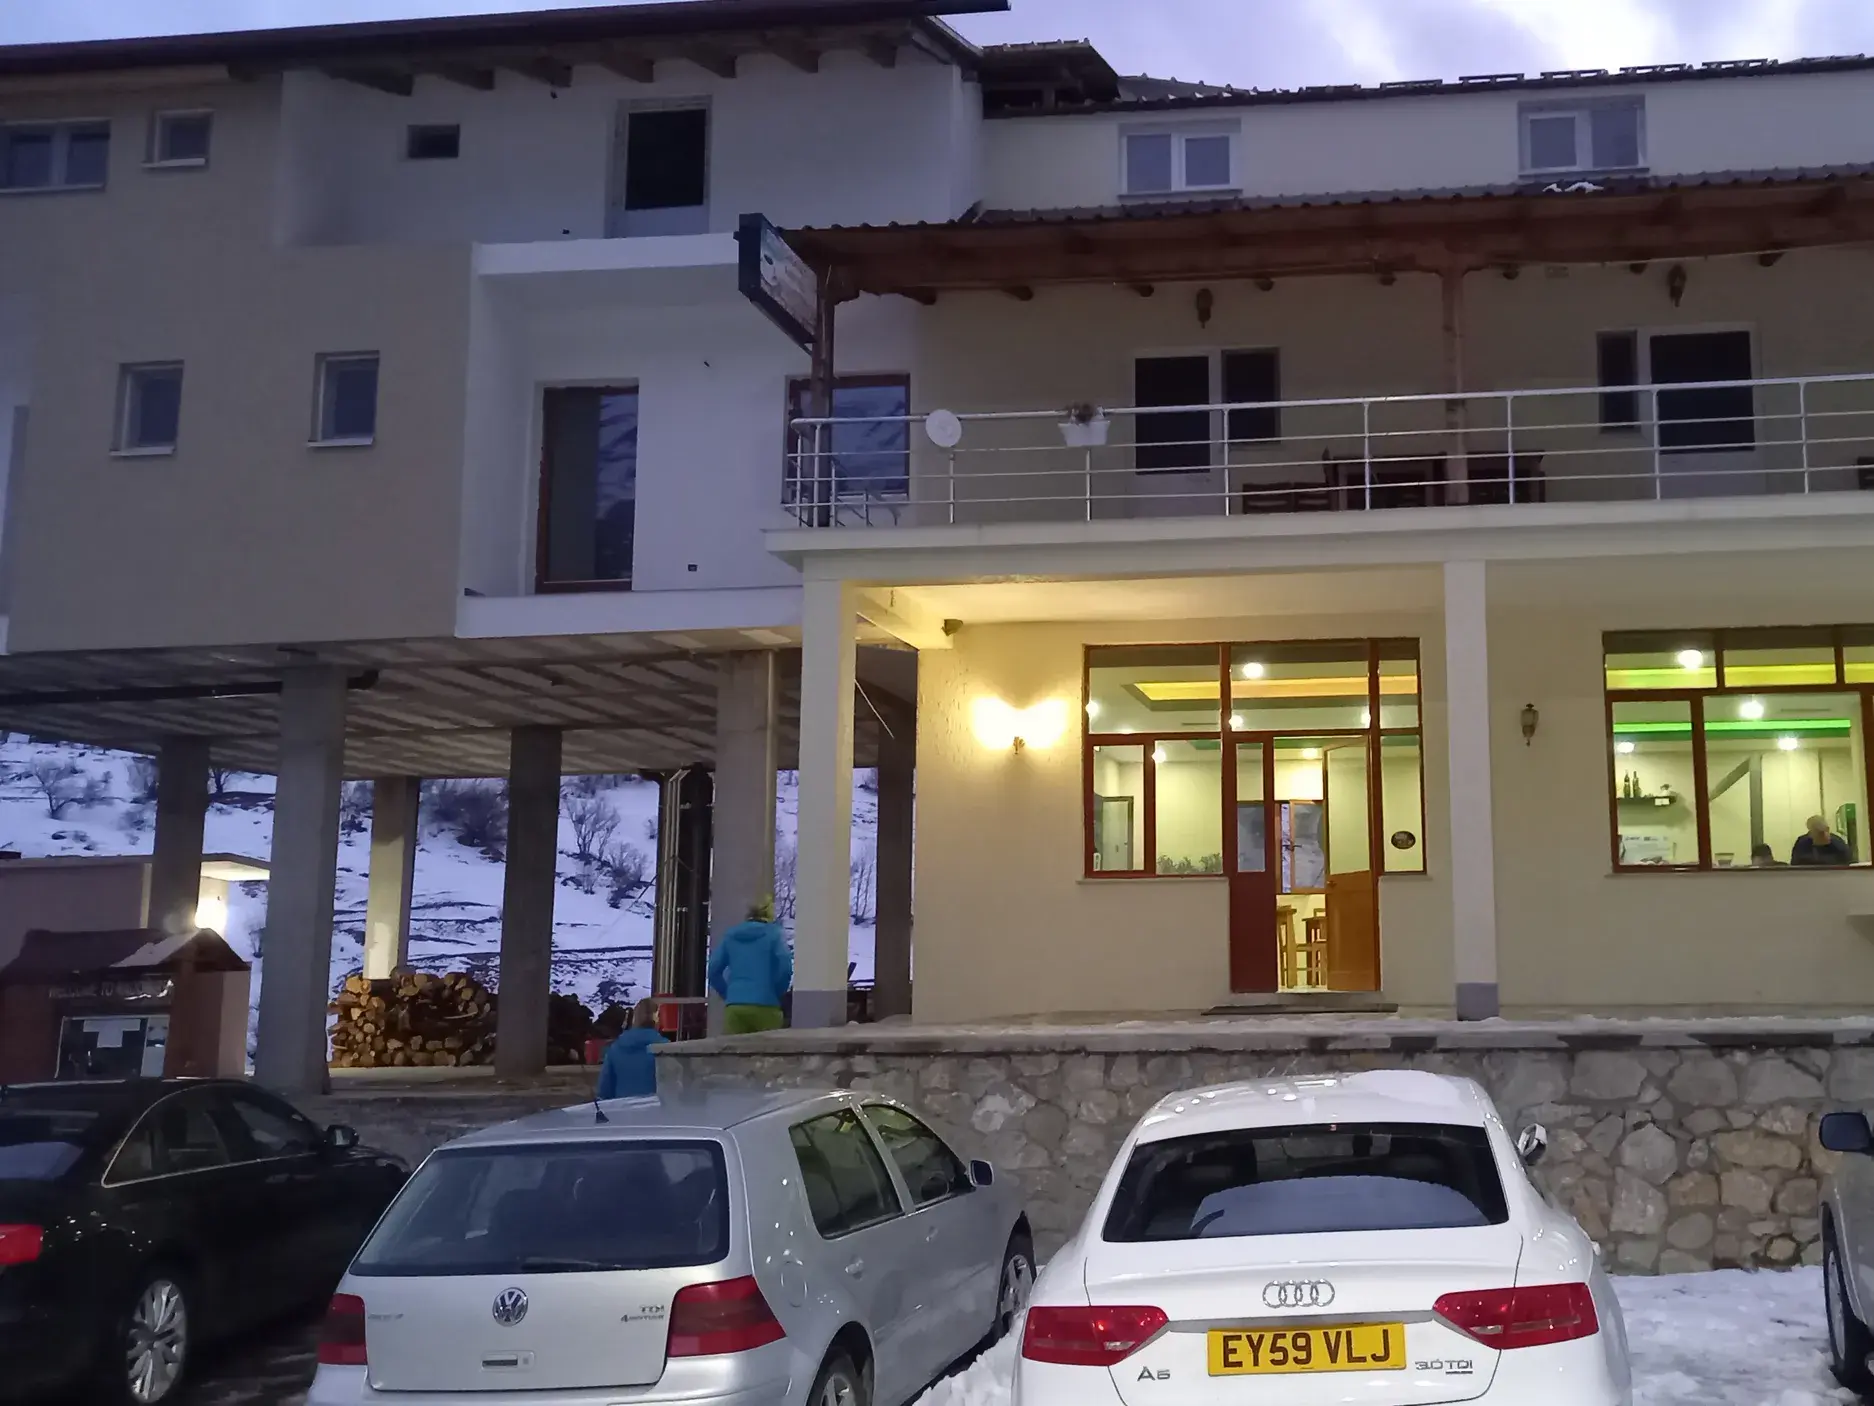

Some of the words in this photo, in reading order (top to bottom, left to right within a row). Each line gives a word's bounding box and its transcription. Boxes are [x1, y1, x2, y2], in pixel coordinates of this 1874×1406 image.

[1222, 1331, 1312, 1368] EY59
[1322, 1328, 1390, 1364] VLJ
[1445, 1360, 1473, 1370] TDI
